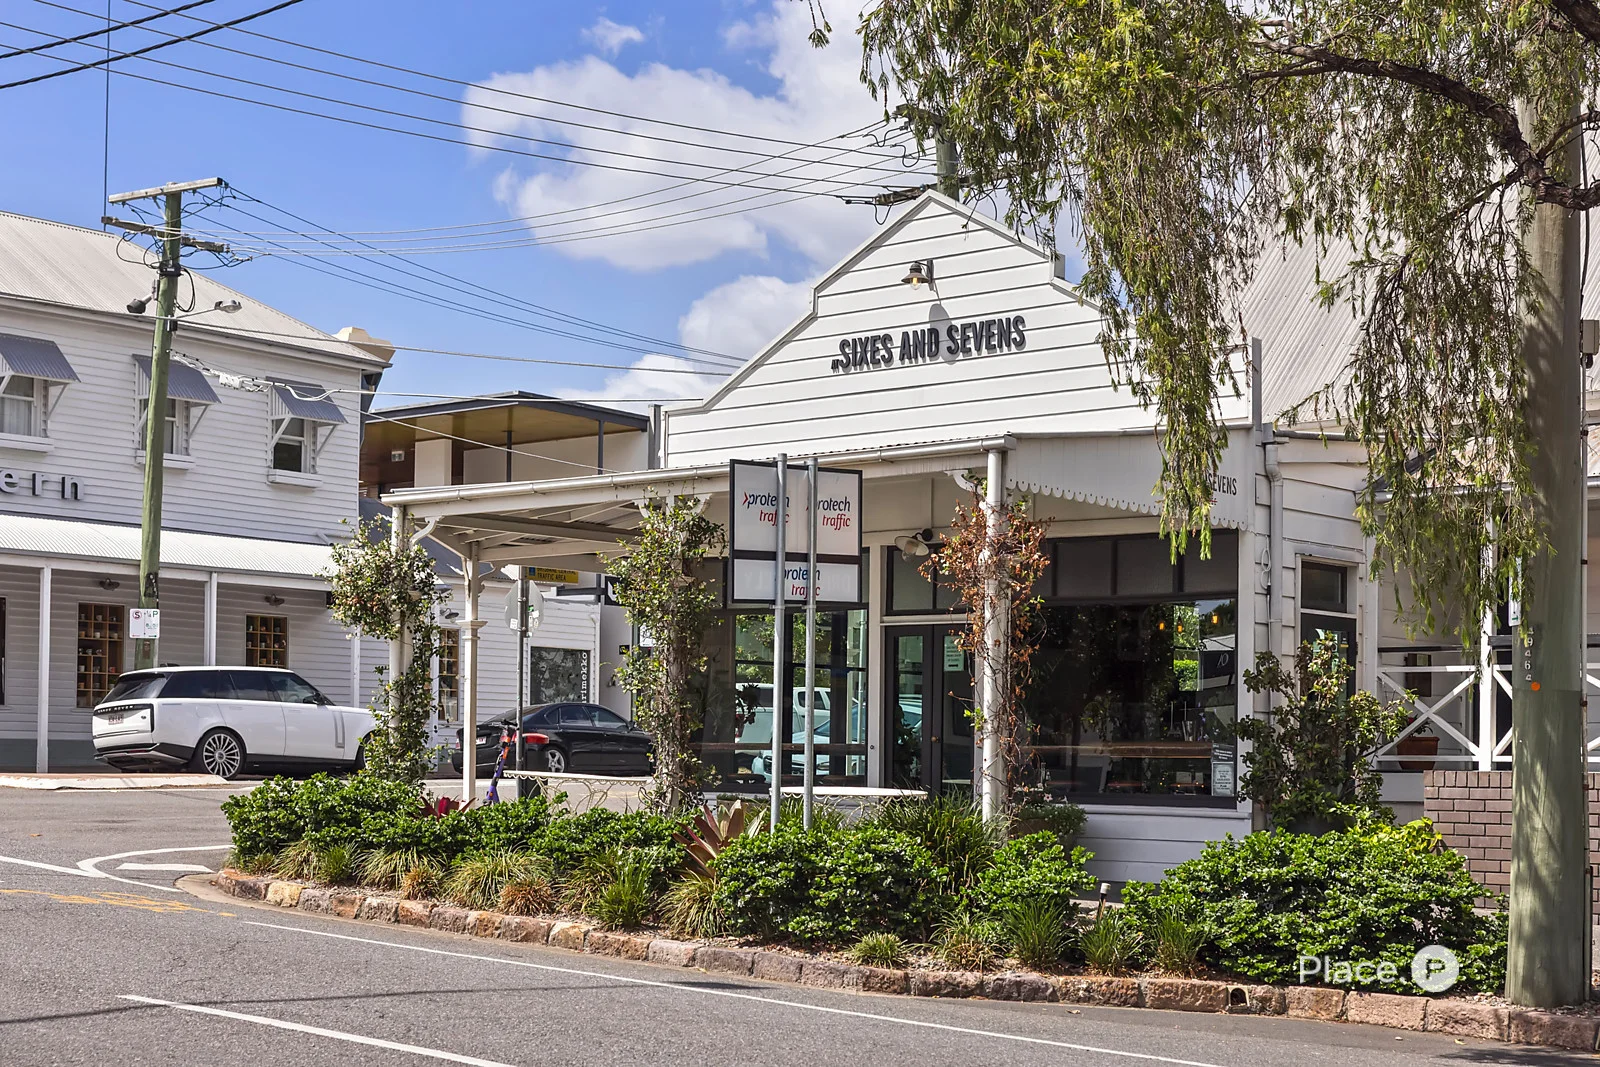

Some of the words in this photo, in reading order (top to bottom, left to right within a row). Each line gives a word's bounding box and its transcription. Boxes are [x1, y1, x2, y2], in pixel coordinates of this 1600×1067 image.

[839, 333, 895, 370] SIXES
[899, 328, 941, 362] AND
[946, 315, 1026, 356] SEVENS
[816, 496, 850, 512] rotech
[822, 513, 851, 531] traffic
